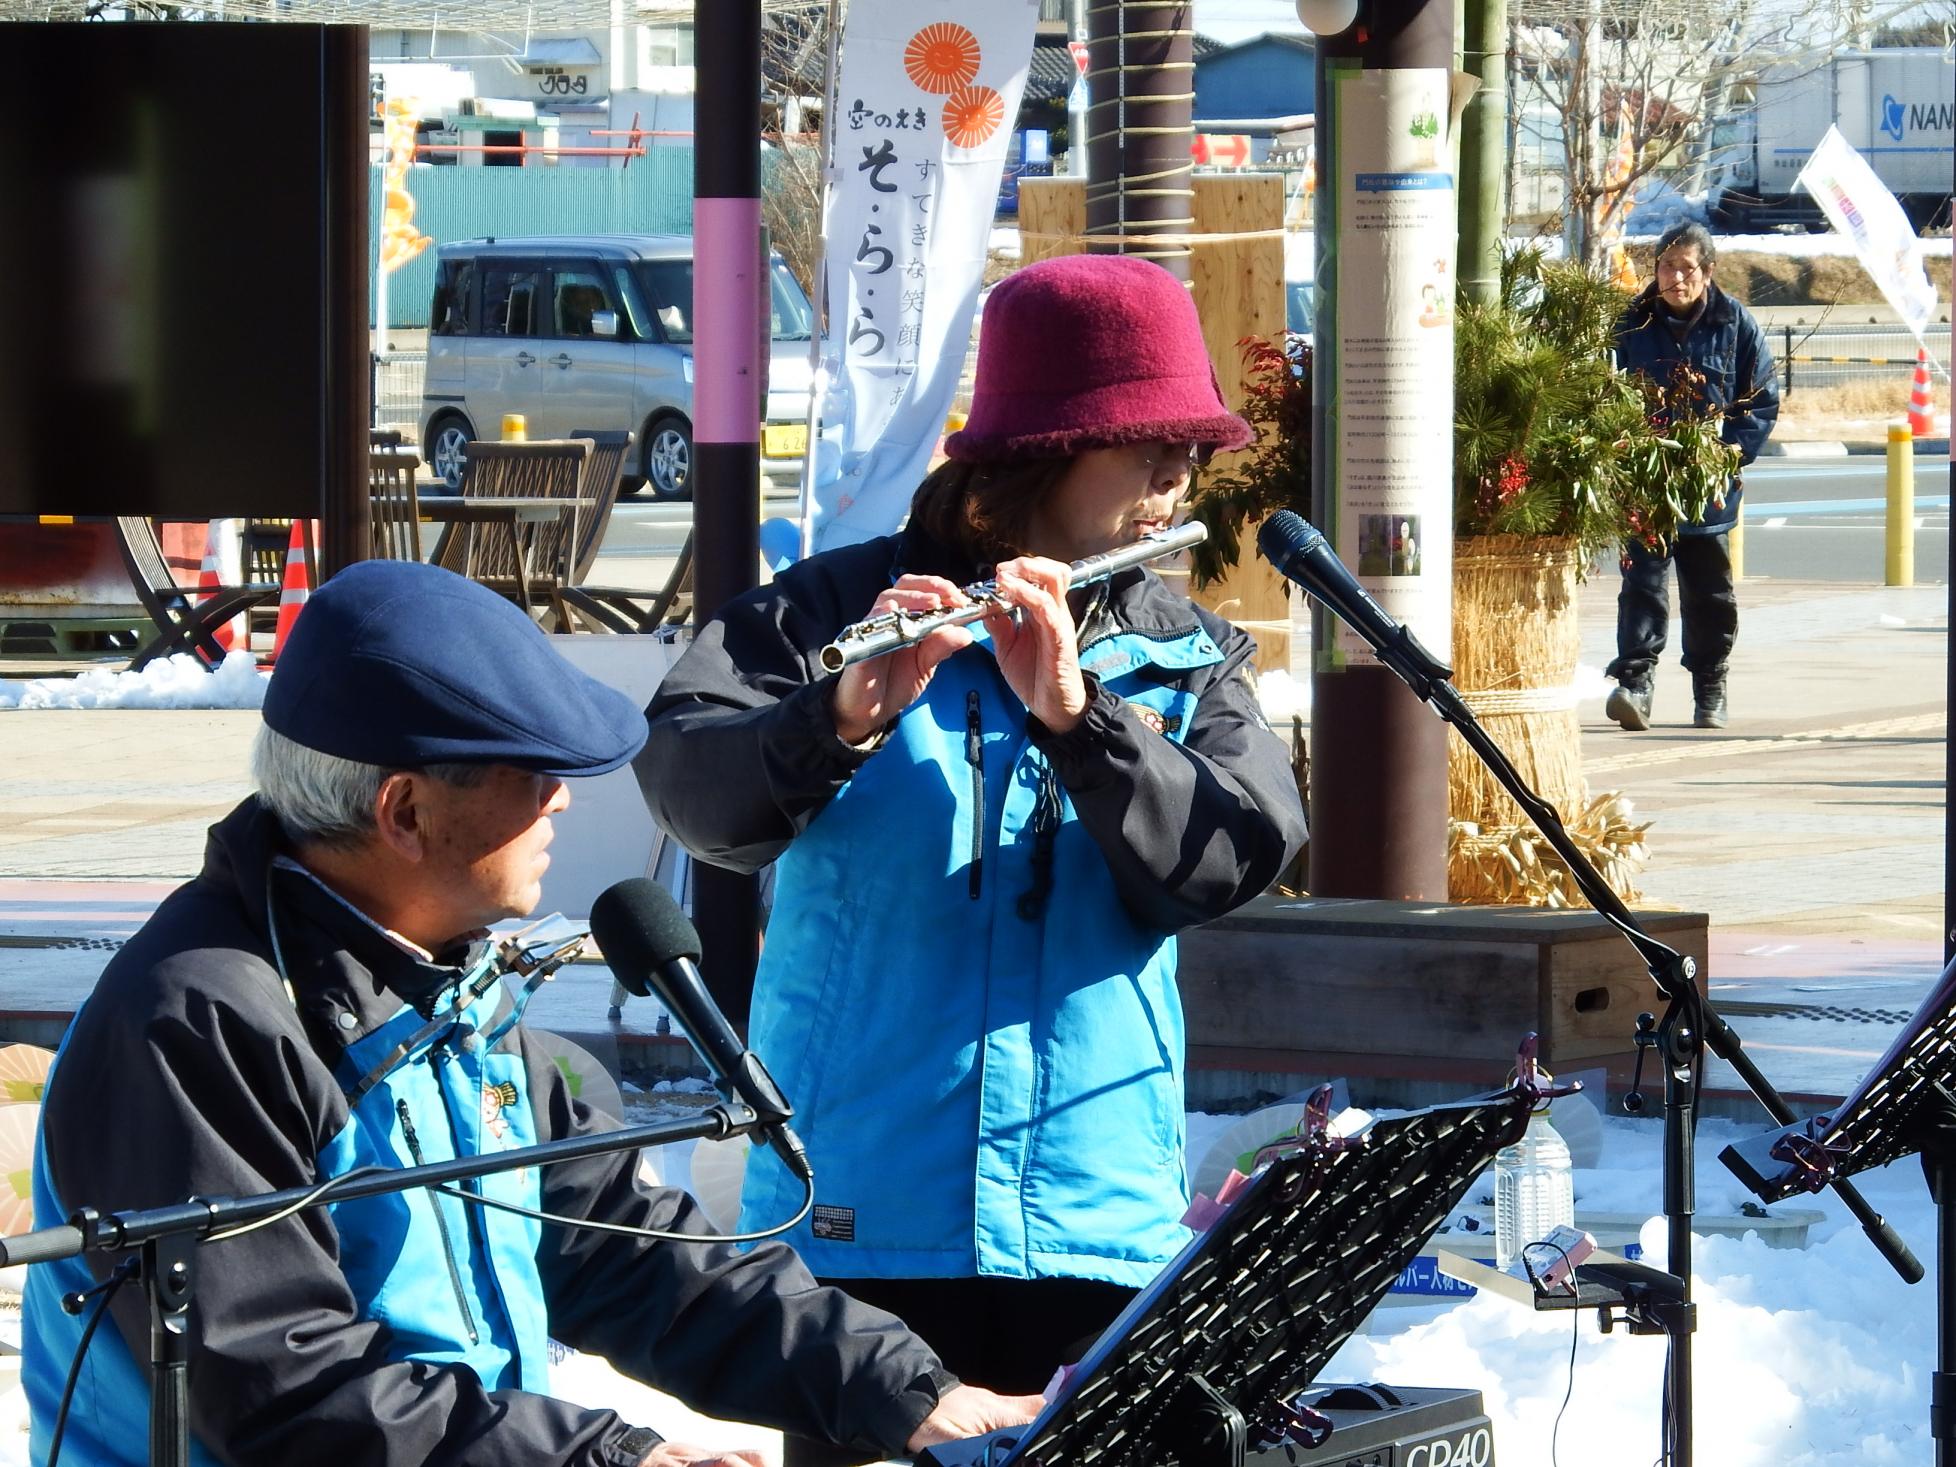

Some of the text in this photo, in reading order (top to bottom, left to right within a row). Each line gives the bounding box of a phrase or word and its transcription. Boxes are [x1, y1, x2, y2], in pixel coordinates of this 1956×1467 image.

[1910, 103, 1954, 130] NAN
[882, 158, 937, 427] すてきな笑顔にあ
